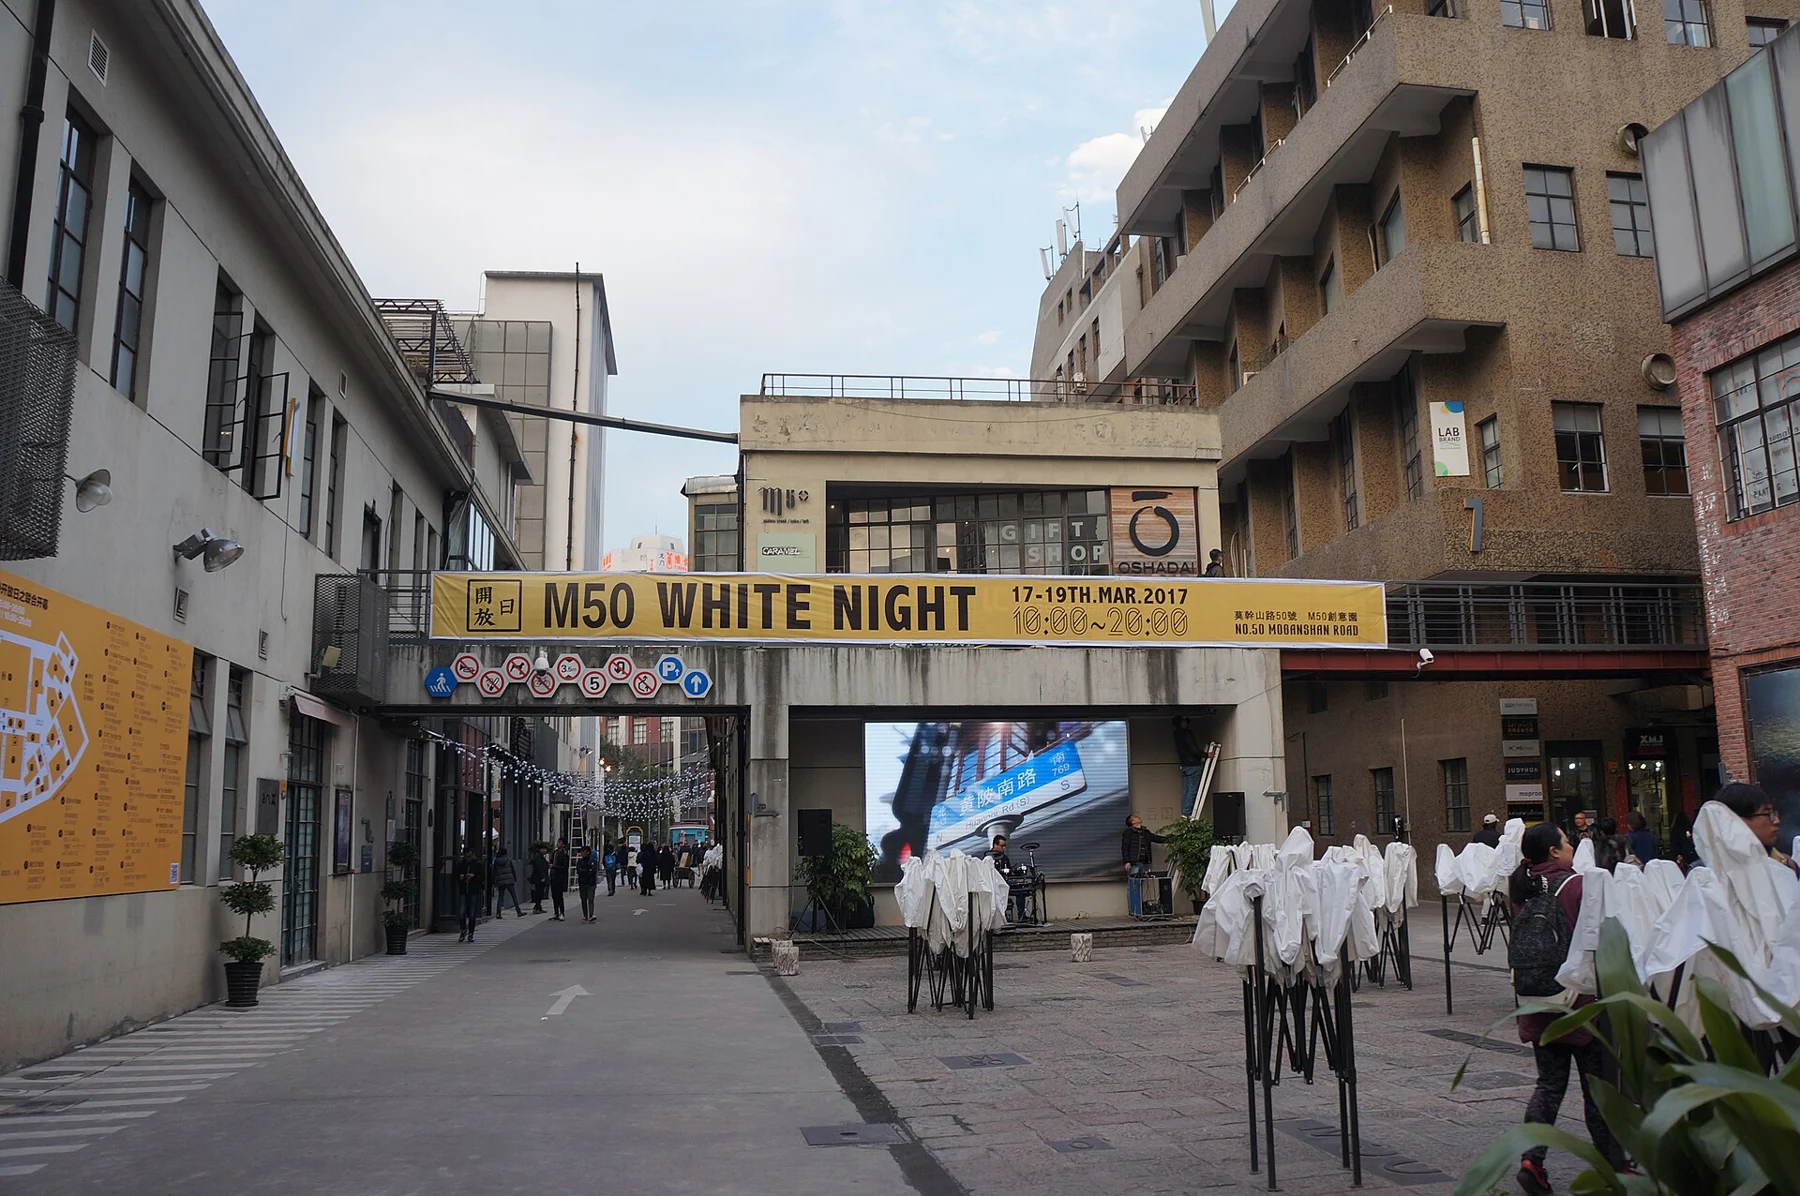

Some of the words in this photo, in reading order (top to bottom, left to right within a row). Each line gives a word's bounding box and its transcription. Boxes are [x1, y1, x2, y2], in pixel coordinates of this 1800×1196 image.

[1438, 427, 1460, 437] LAB
[1001, 521, 1084, 540] GIFT
[1464, 497, 1483, 552] 7
[1027, 545, 1105, 562] SHOP
[1118, 561, 1195, 574] OSHADAI
[1012, 586, 1188, 605] 17-19TH.MAR.2017
[544, 582, 635, 630] M50
[657, 582, 811, 630] WHITE
[833, 585, 976, 632] NIGHT
[1012, 605, 1188, 637] 10:00~20:00
[1235, 623, 1265, 635] NO.50
[1268, 623, 1330, 636] MOGANSHAN
[1333, 624, 1359, 636] ROAD
[662, 661, 676, 677] P
[590, 676, 600, 690] 5
[1051, 751, 1066, 765] 南
[1052, 763, 1070, 776] 769
[959, 767, 1037, 816] 黄陂南路
[1060, 779, 1071, 791] S
[1001, 803, 1015, 814] Rd
[1016, 796, 1030, 808] (S)
